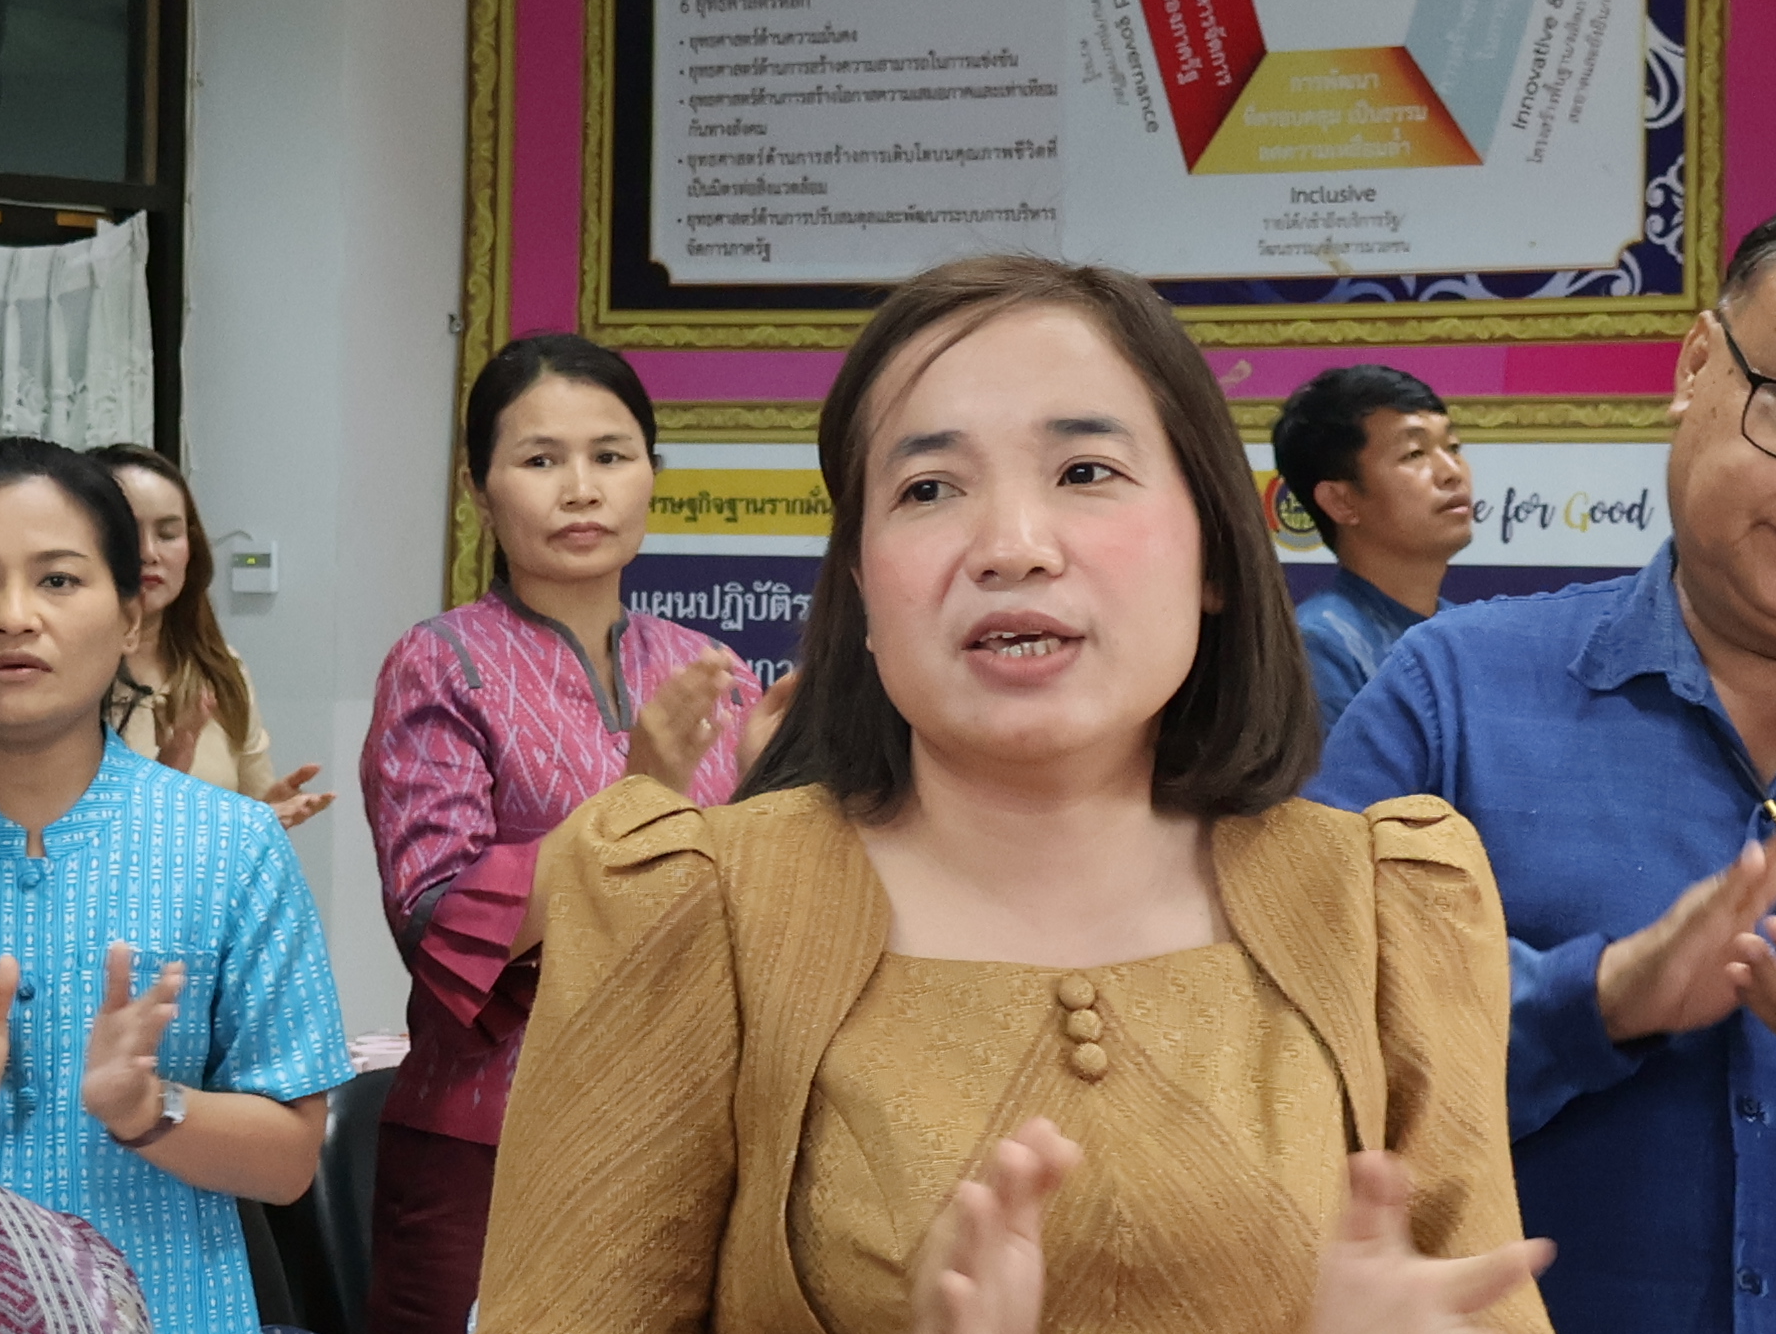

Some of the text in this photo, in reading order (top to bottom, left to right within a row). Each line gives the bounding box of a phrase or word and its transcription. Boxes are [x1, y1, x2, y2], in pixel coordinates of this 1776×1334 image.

[1113, 12, 1160, 135] governance
[1511, 14, 1559, 131] Innovative
[1290, 185, 1377, 204] Inclusive
[1499, 486, 1556, 544] for
[1563, 488, 1656, 534] Good
